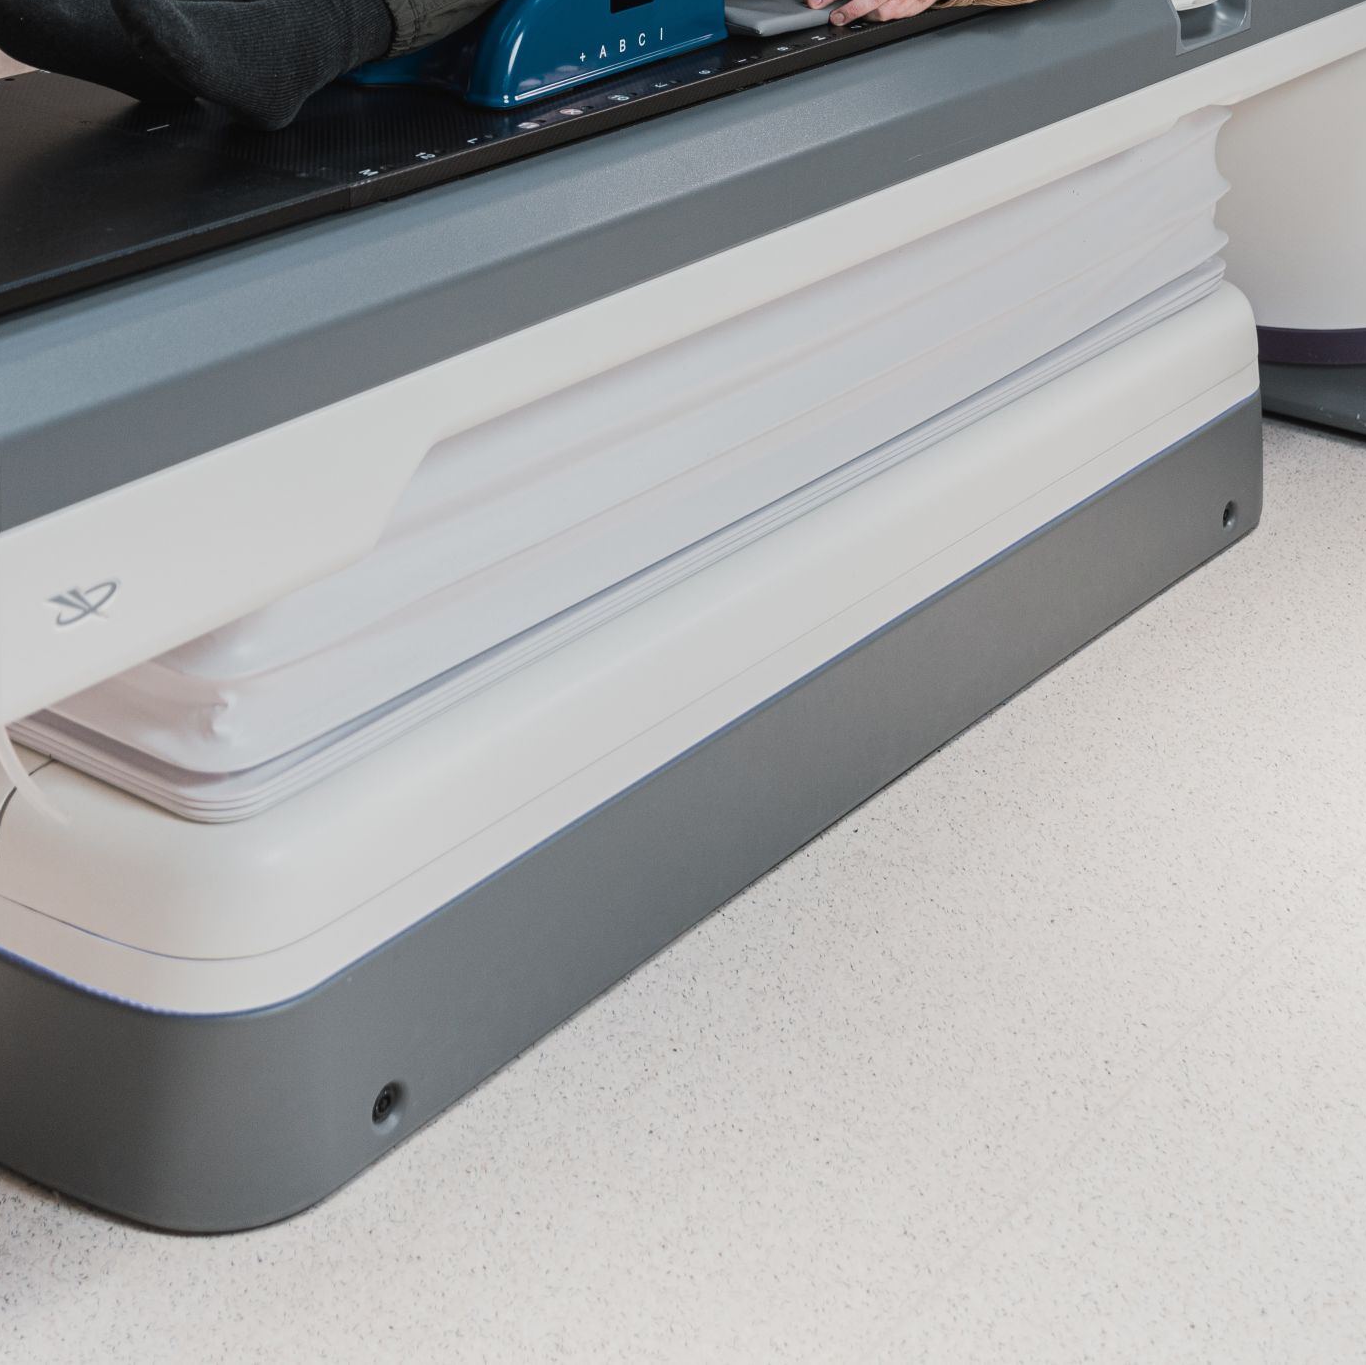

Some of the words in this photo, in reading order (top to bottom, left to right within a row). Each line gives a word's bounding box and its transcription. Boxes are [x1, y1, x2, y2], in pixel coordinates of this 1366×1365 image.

[599, 44, 607, 59] A
[619, 39, 627, 53] B
[638, 32, 646, 47] C
